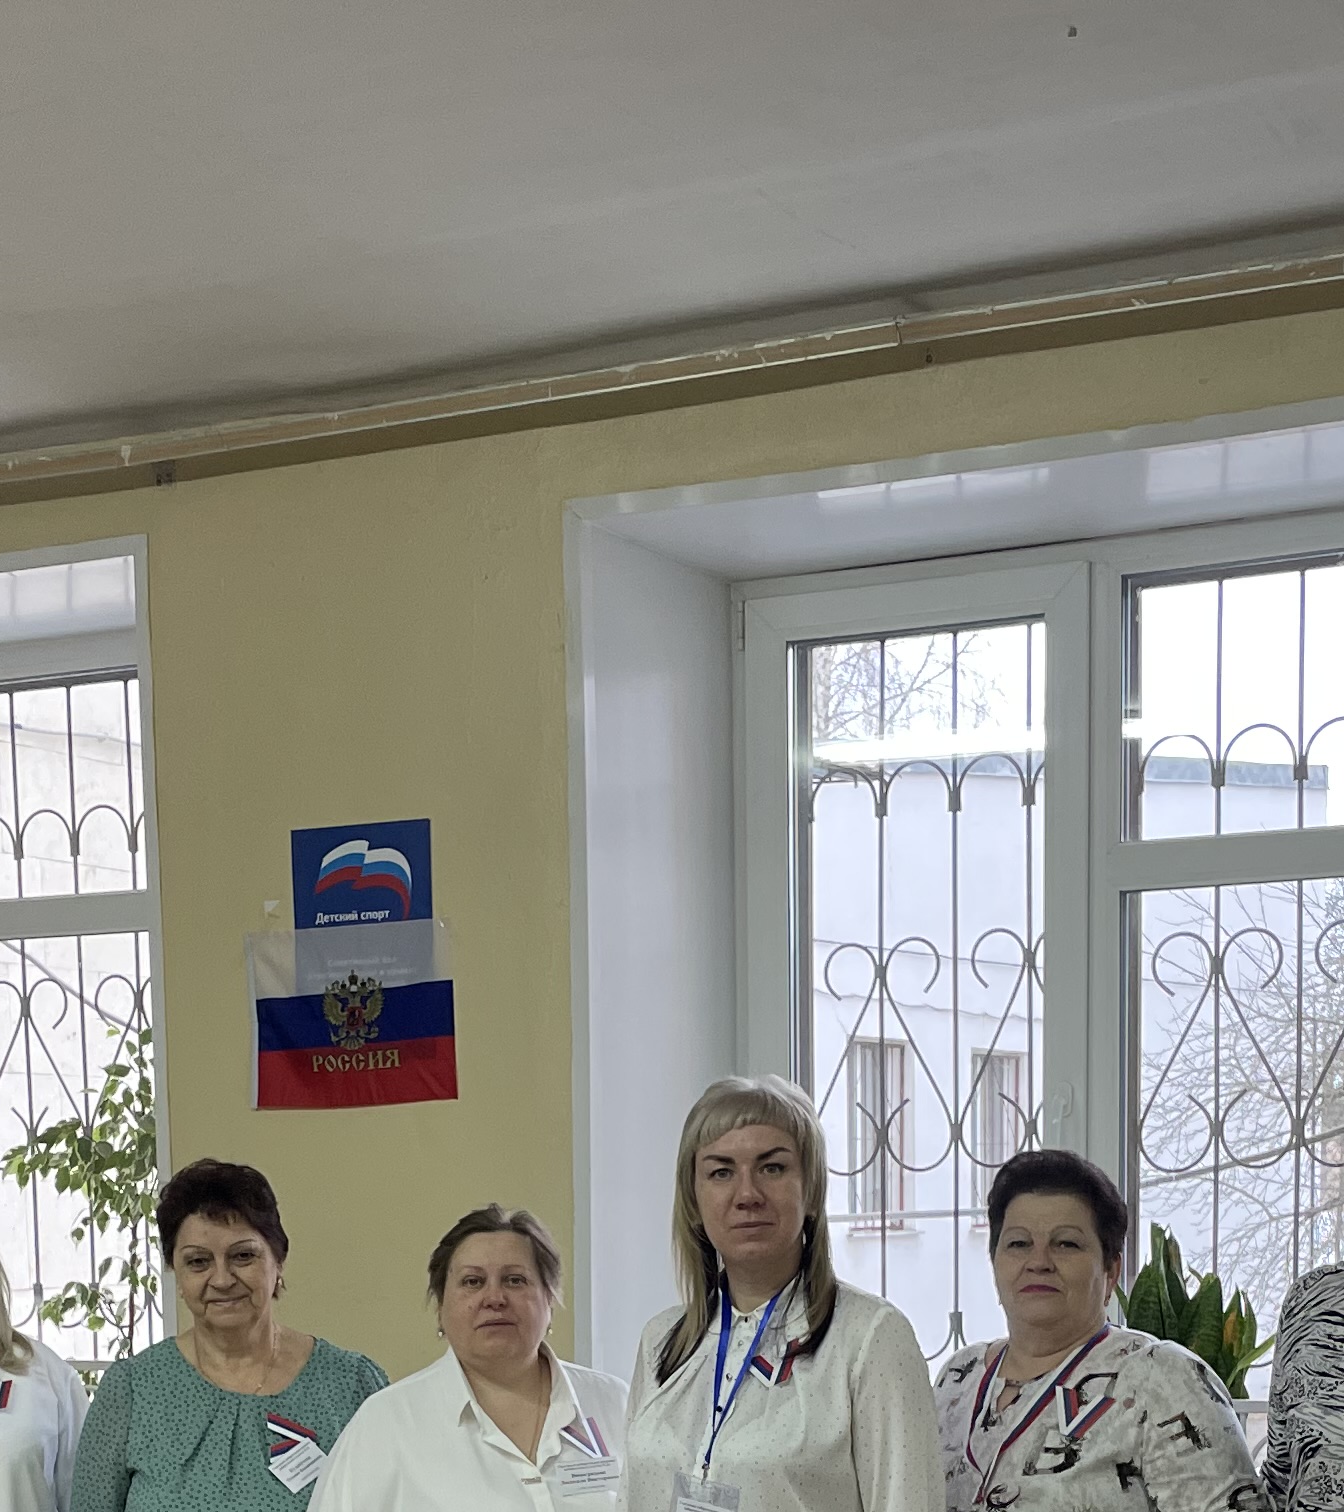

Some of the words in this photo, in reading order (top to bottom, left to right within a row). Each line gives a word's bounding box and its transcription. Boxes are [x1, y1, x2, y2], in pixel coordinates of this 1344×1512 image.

[315, 909, 358, 925] Детский
[360, 909, 390, 925] спорт
[312, 1049, 401, 1072] РОССИЯ
